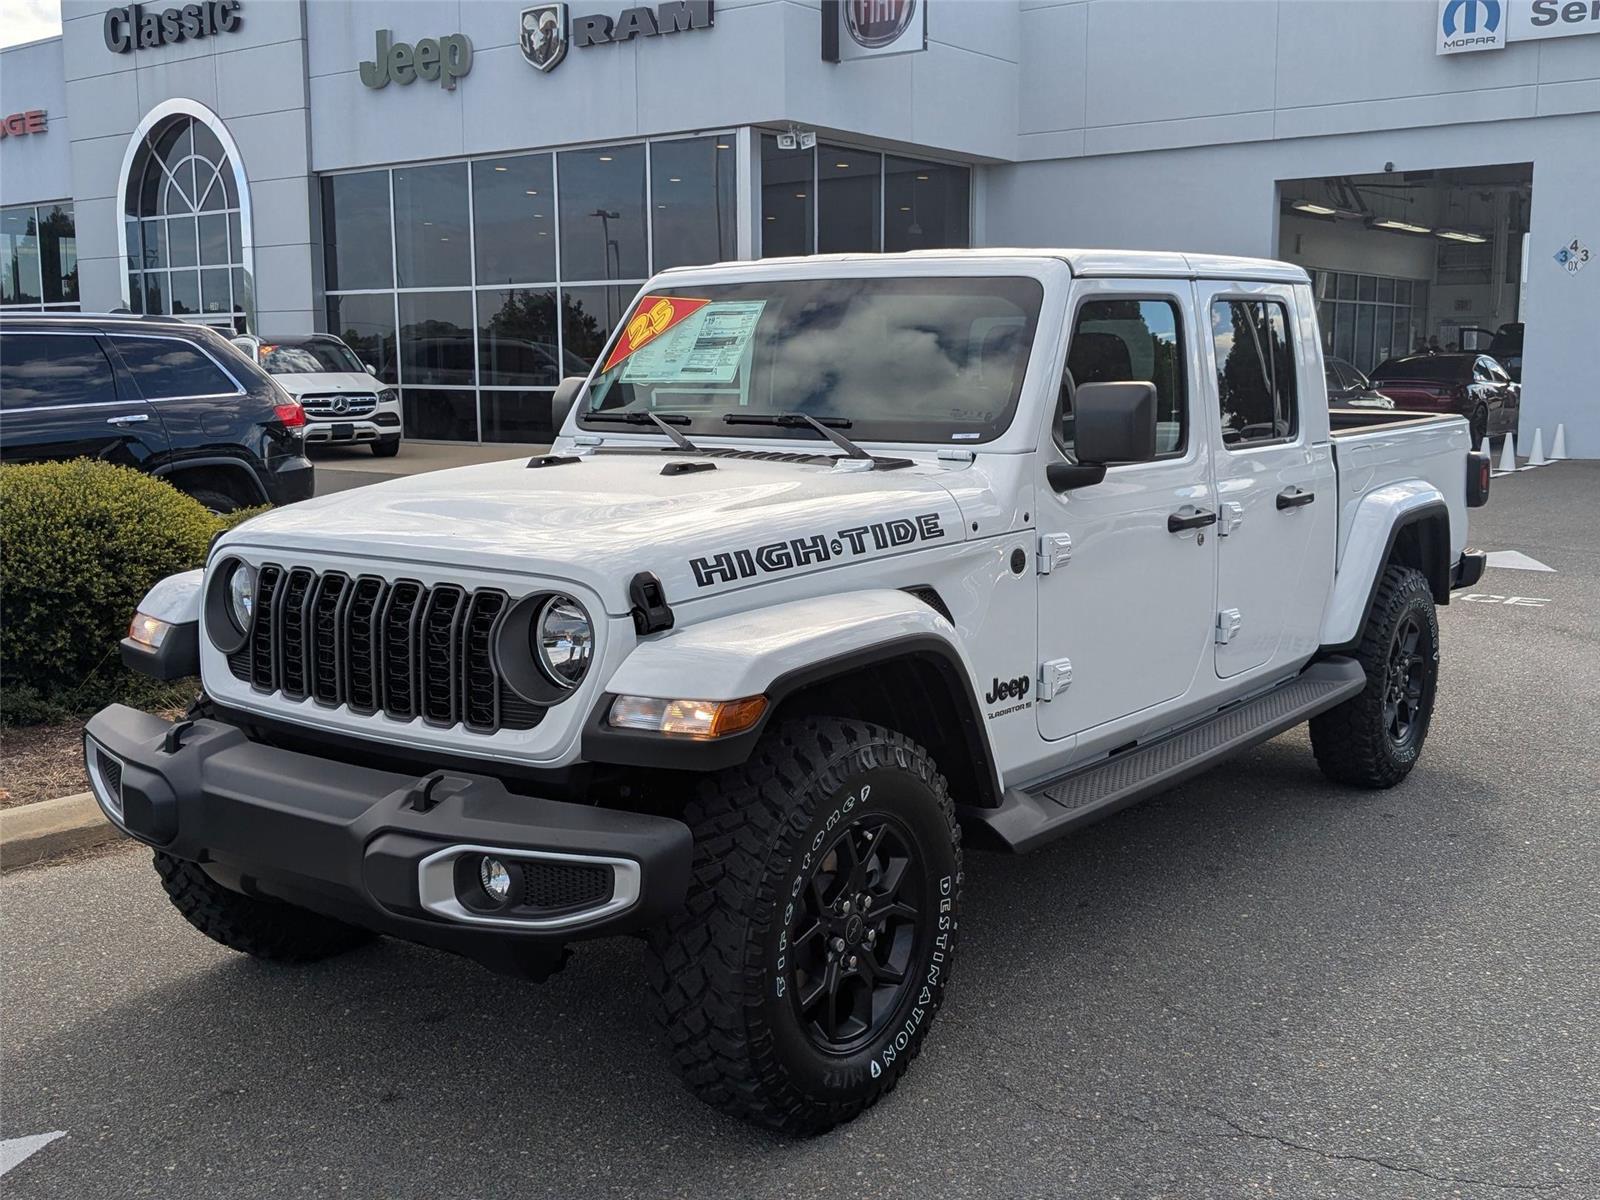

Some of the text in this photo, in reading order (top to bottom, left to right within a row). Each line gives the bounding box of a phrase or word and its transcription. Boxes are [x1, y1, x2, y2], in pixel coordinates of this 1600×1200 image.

[104, 0, 241, 53] Classic
[573, 0, 714, 48] RAM
[1443, 36, 1496, 49] MOPAR
[359, 29, 473, 91] Jeep
[1559, 249, 1589, 263] 3 3
[1569, 239, 1579, 252] 4
[626, 298, 675, 351] 25
[689, 512, 945, 588] HIGH TIDE
[985, 674, 1030, 705] Jeep
[883, 875, 952, 1068] DESTINATION
